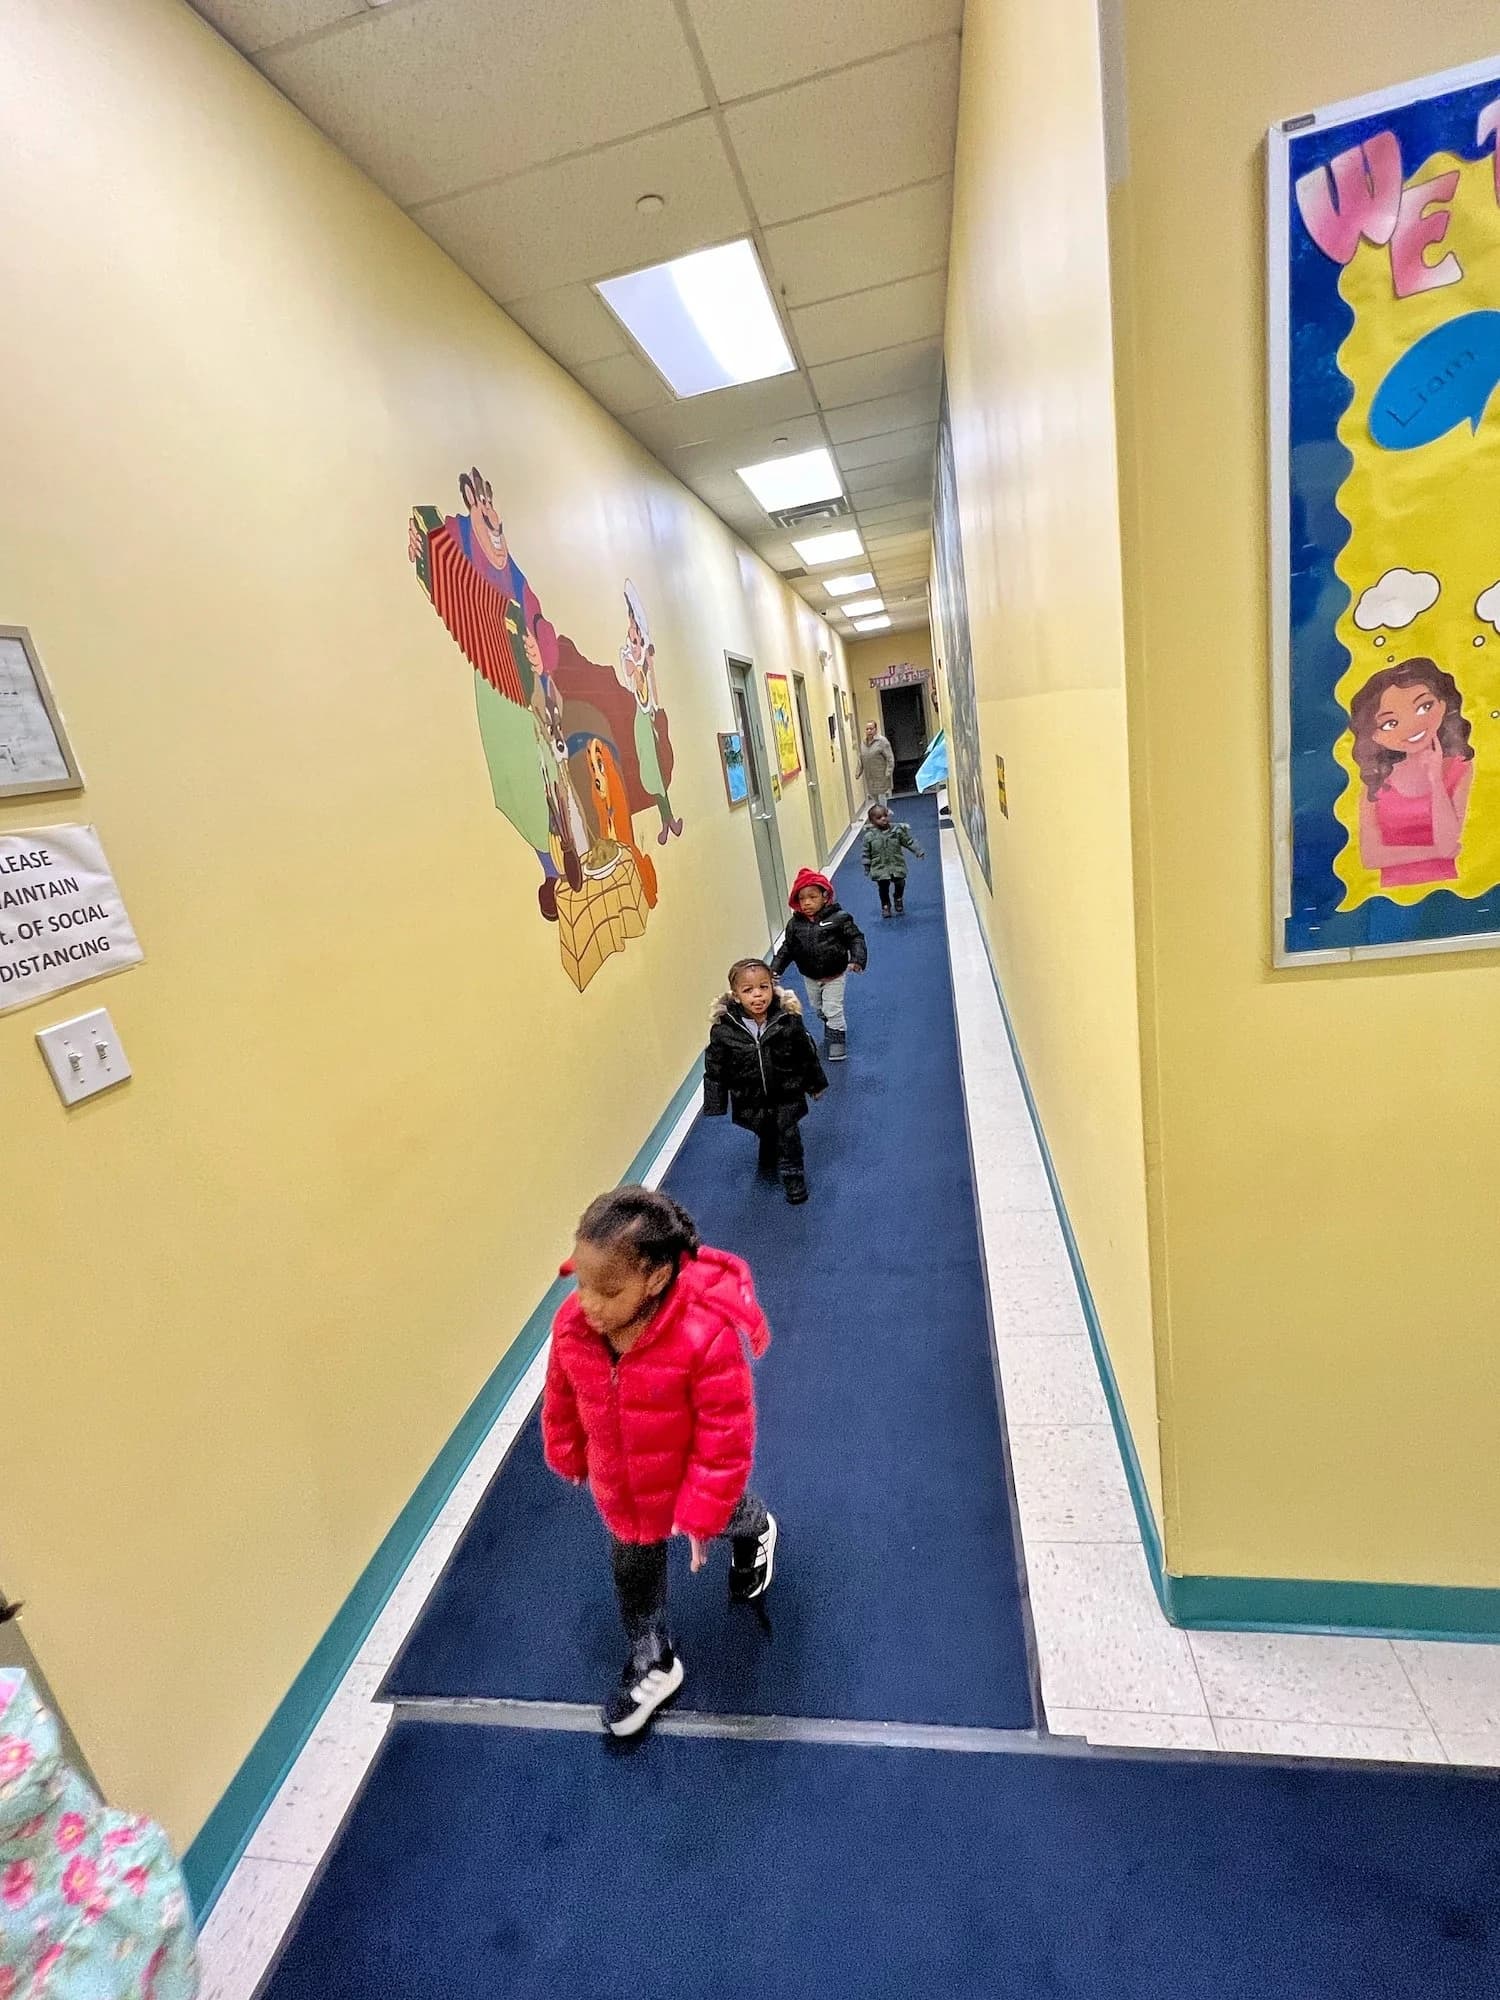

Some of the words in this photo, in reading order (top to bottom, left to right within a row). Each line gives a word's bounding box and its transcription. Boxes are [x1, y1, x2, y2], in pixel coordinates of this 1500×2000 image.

[1296, 130, 1463, 299] WE
[1386, 351, 1475, 427] Liam
[0, 877, 80, 909] AINTAIN
[18, 920, 44, 940] OF
[48, 904, 109, 932] SOCIAL
[0, 936, 110, 982] DISTANCING
